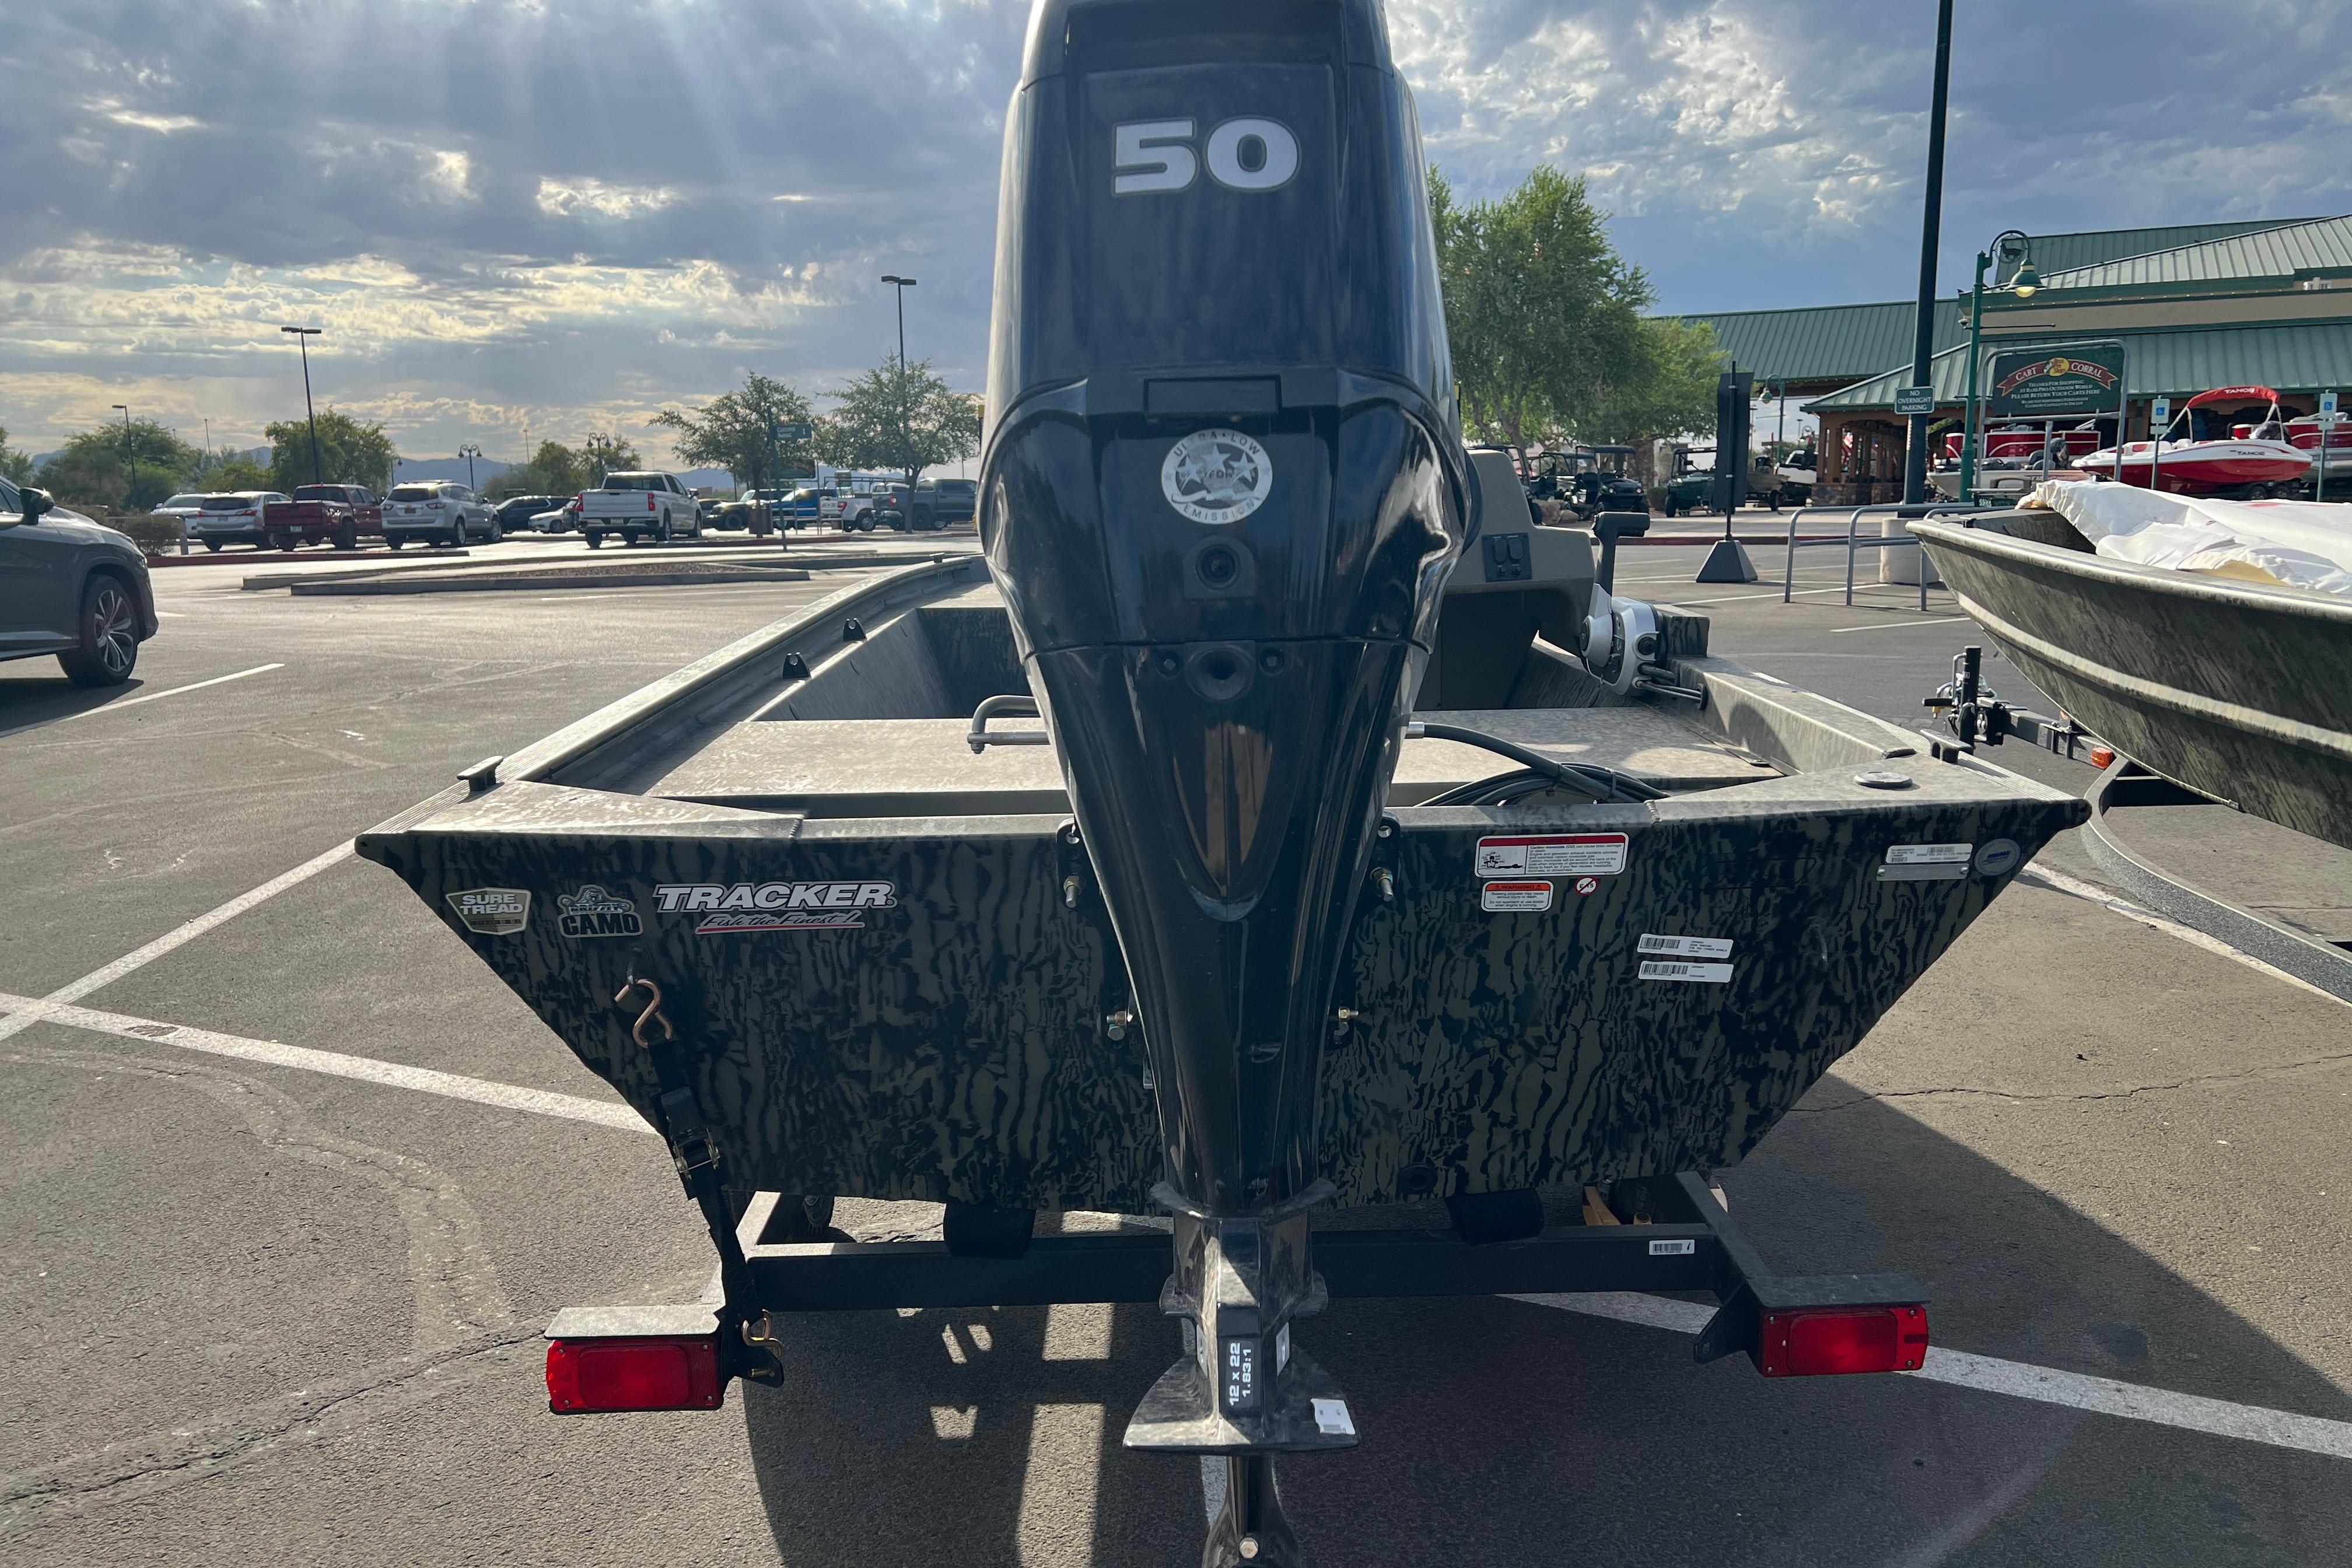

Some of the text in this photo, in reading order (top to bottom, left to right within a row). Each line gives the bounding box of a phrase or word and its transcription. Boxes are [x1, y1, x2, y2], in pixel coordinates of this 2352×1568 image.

[1115, 118, 1298, 195] 50
[2015, 367, 2037, 381] CART
[2071, 362, 2102, 378] CORRAL
[1231, 433, 1261, 455] LOW
[1184, 498, 1255, 522] EMISSION
[462, 894, 516, 905] SURE
[656, 883, 892, 911] TRACKER
[459, 904, 524, 915] TREAD
[561, 913, 640, 935] CAMO
[703, 916, 744, 927] Fish
[747, 915, 776, 926] the
[1229, 1342, 1241, 1406] 12 x 22
[1242, 1348, 1252, 1398] 1.83:1
